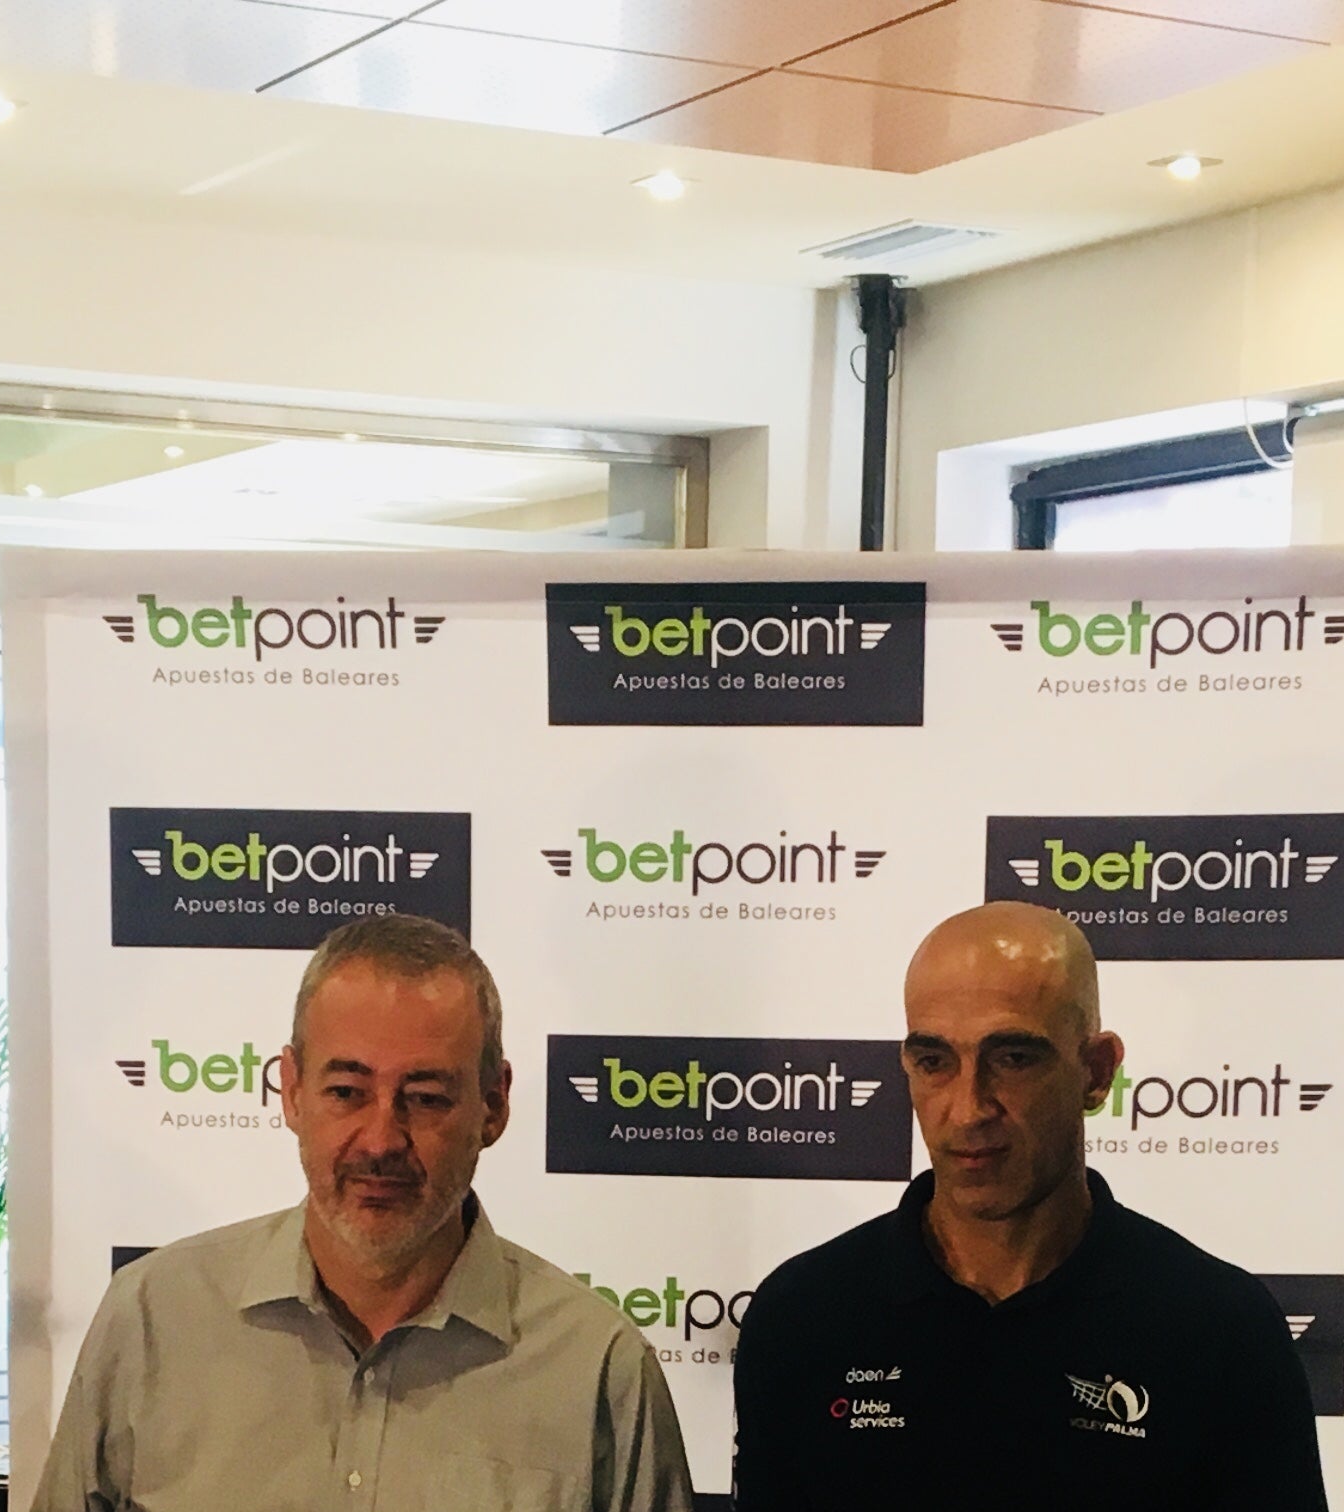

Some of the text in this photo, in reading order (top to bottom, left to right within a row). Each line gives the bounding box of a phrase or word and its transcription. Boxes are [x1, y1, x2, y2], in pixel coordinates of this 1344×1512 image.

[138, 595, 404, 660] betpoint
[605, 606, 854, 668] betpoint
[1031, 597, 1314, 668] betpoint
[153, 667, 400, 688] Apuestas de Baleares
[614, 673, 845, 693] Apuestas de Baleares
[1038, 673, 1303, 698] Apuestas de Baleares
[165, 831, 403, 893] betpoint
[579, 829, 845, 895] betpoint
[1045, 838, 1298, 902] betpoint
[175, 898, 395, 917] Apuestas de Baleares
[586, 901, 836, 923] Apuestas de Baleares
[1054, 905, 1288, 927] puestas de Baleares
[152, 1040, 282, 1106] betp
[604, 1058, 844, 1120] betpoint
[1084, 1062, 1290, 1130] tpoint
[161, 1111, 259, 1131] Apuestas
[611, 1124, 836, 1144] Apuestas de Baleares
[1141, 1136, 1170, 1155] de
[1179, 1136, 1279, 1155] Baleares
[691, 1347, 720, 1365] de
[852, 1399, 891, 1415] Urbia
[849, 1416, 906, 1429] services
